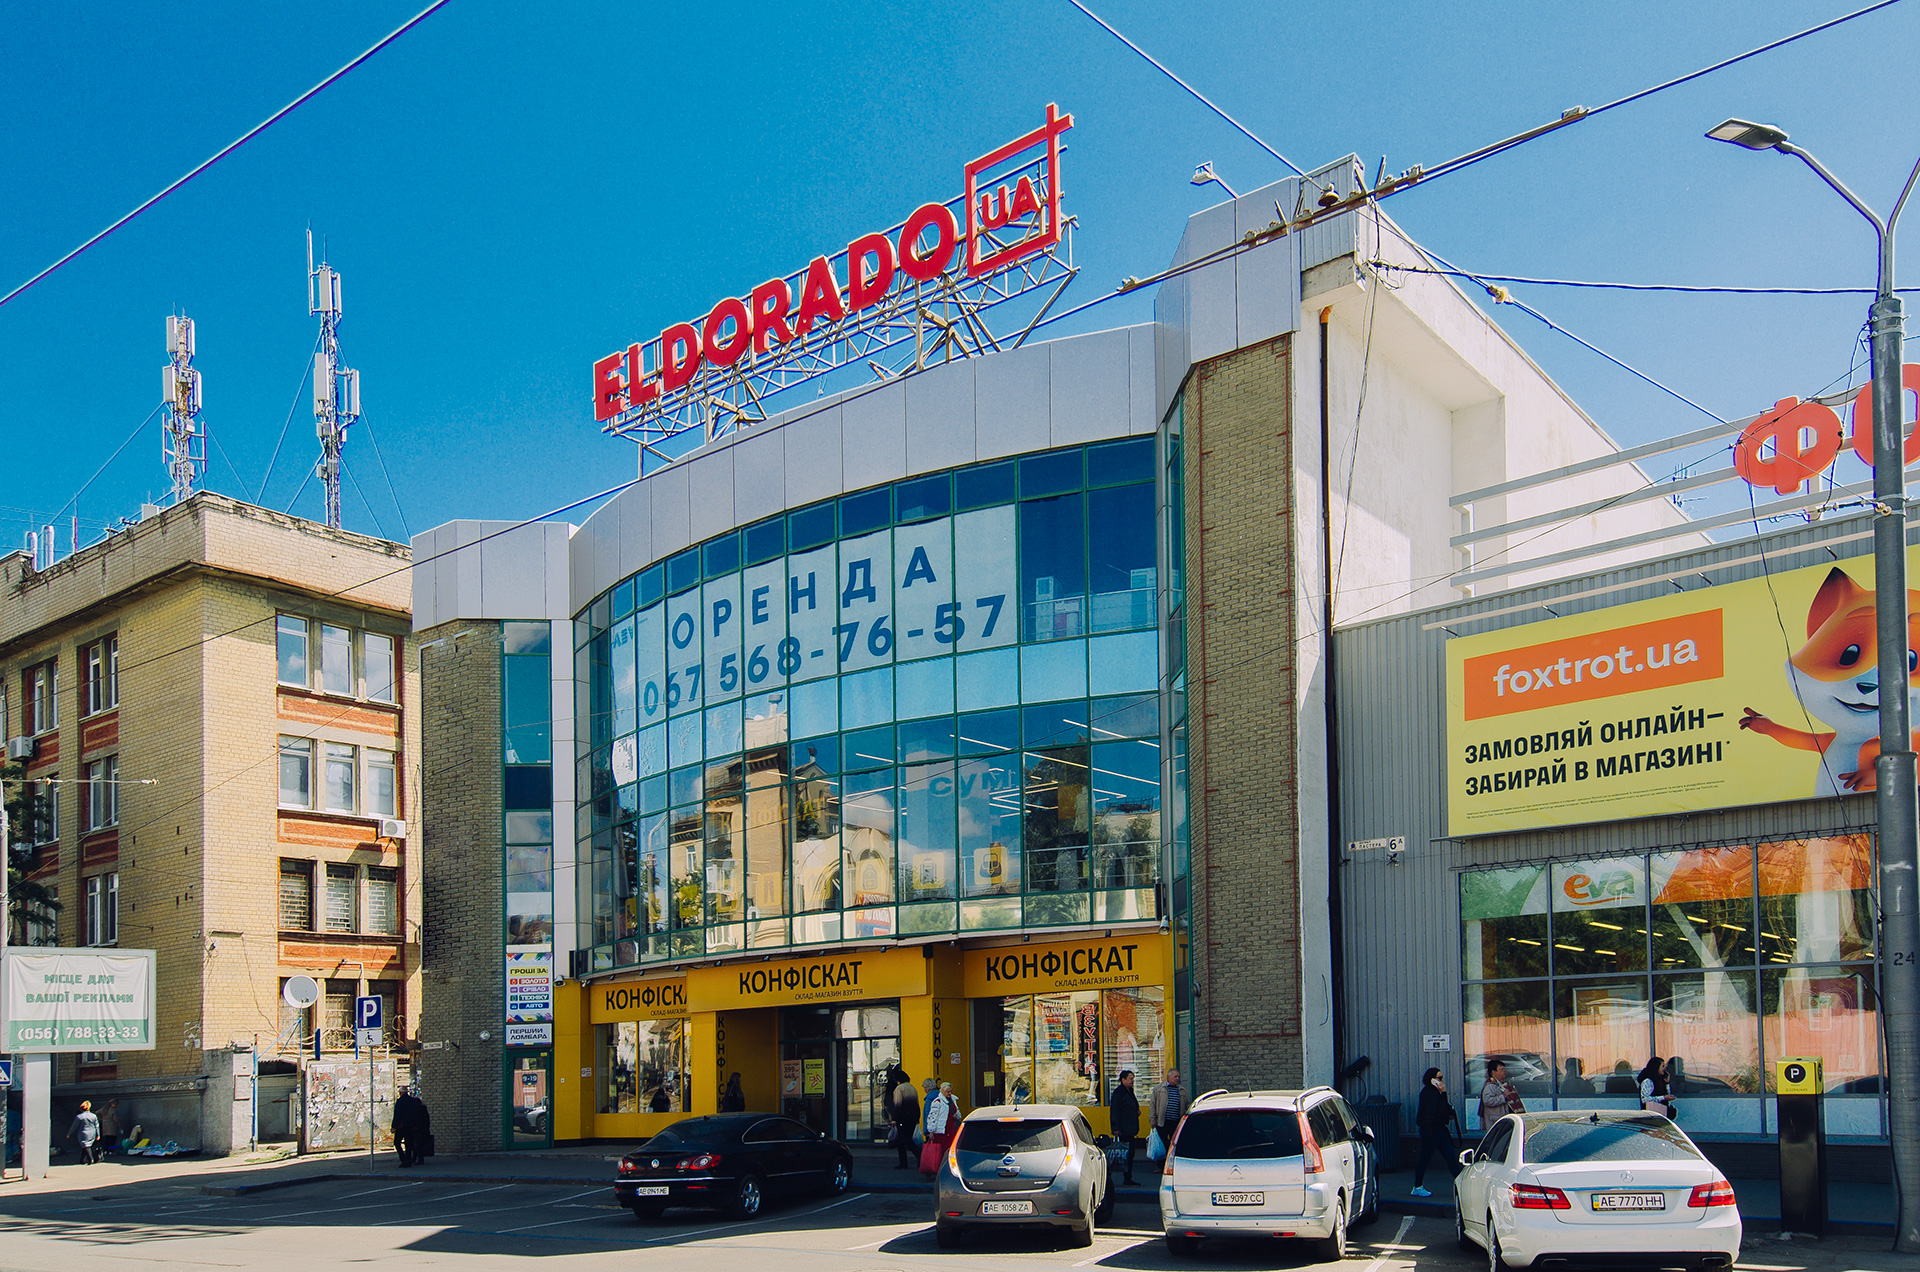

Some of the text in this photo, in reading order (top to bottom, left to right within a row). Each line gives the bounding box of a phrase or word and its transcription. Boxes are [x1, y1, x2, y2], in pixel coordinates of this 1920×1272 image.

[593, 174, 1042, 423] ELDORADO UA
[671, 545, 938, 650] ОРЕНДА
[642, 593, 1008, 718] 067 568-76-57
[1492, 637, 1699, 697] foxtrot.ua
[1464, 721, 1593, 765] ЗАМОВЛЯЙ
[1465, 757, 1567, 797] ЗАБИРАЙ
[1574, 759, 1590, 781] В
[1563, 866, 1636, 900] eva
[986, 944, 1138, 982] КОНФІСКАТ
[1893, 951, 1915, 966] 24
[44, 974, 115, 985] МІСЦЕ ДЛЯ
[739, 960, 863, 995] КОНФІСКАТ
[1054, 974, 1139, 988] СКЛАД-МАГАЗИН ВЗУТТЯ
[26, 991, 134, 1004] ВАШОЇ РЕКЛАМИ
[794, 988, 863, 1001] СКЛАД-МАГАЗИН ВЗУТТЯ
[363, 999, 378, 1027] P
[17, 1026, 140, 1041] (056) 788-33-33
[509, 1027, 543, 1035] ПЕРШИЙ
[510, 1033, 548, 1041] ЛОМБАРД
[1790, 1067, 1800, 1079] P
[1218, 1194, 1262, 1203] AE 9097 CC
[1600, 1195, 1662, 1207] AE 7770 HH
[989, 1203, 1029, 1212] AE 1058 ZA
